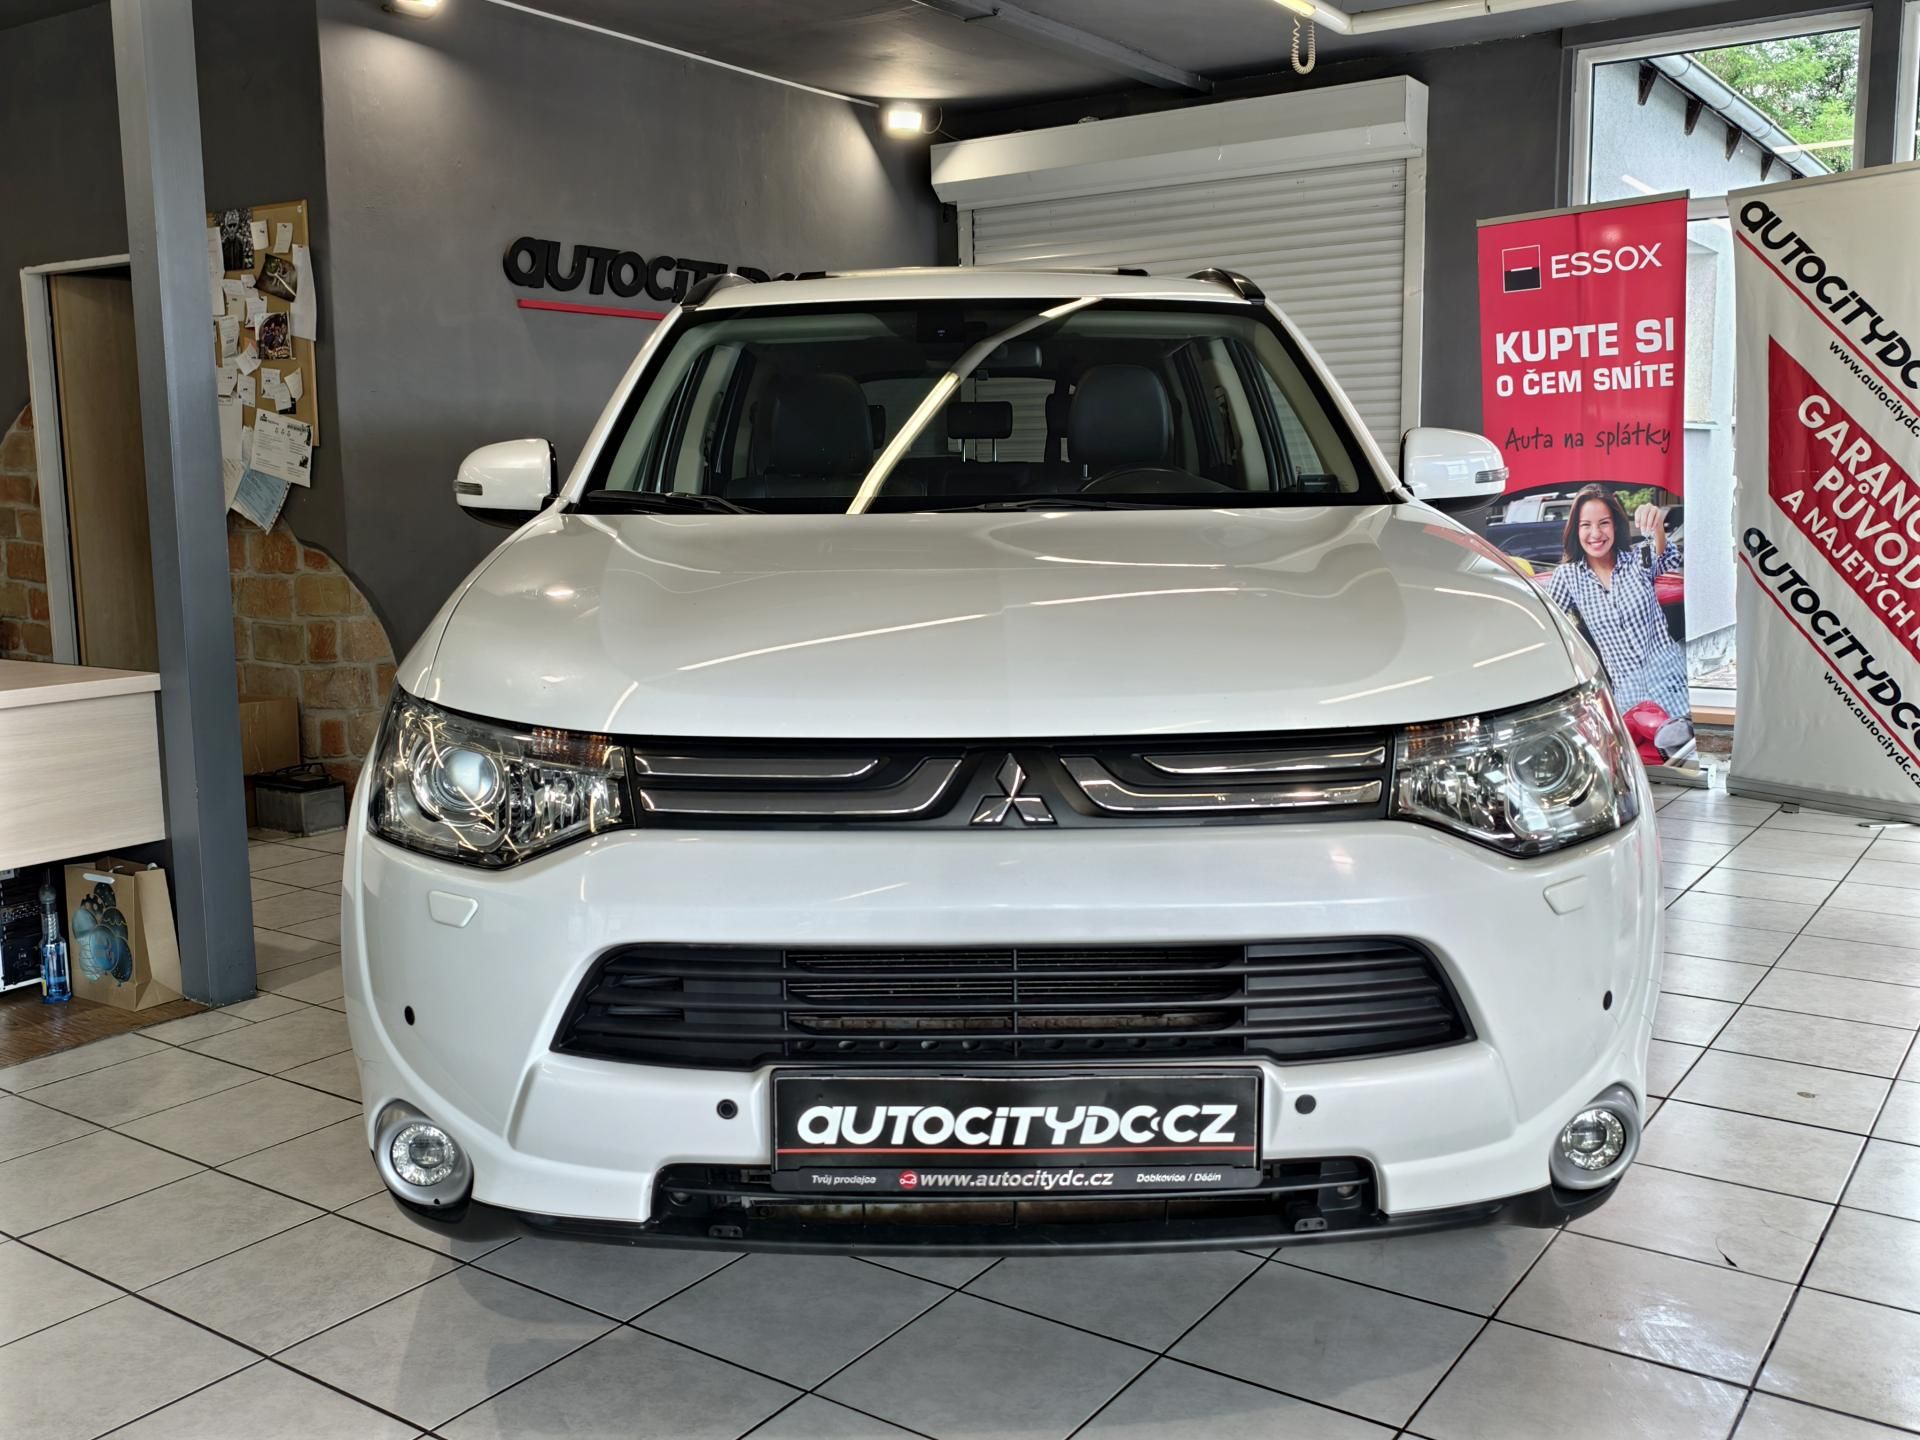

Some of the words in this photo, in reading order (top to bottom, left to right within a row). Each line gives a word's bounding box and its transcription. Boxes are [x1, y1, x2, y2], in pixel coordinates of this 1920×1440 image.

[1551, 242, 1662, 279] ESSOX
[1496, 322, 1619, 365] KUPTE
[1636, 317, 1674, 354] SI
[1496, 374, 1514, 398] O
[1522, 368, 1582, 396] ČEM
[1593, 360, 1674, 392] SNÍTE
[1505, 427, 1553, 450] Auta
[1564, 433, 1584, 448] na
[1595, 422, 1671, 455] splátky
[1781, 489, 1805, 514] A
[1802, 506, 1916, 628] NAJETÝCH
[920, 1169, 1114, 1191] www.autocitydc.cz
